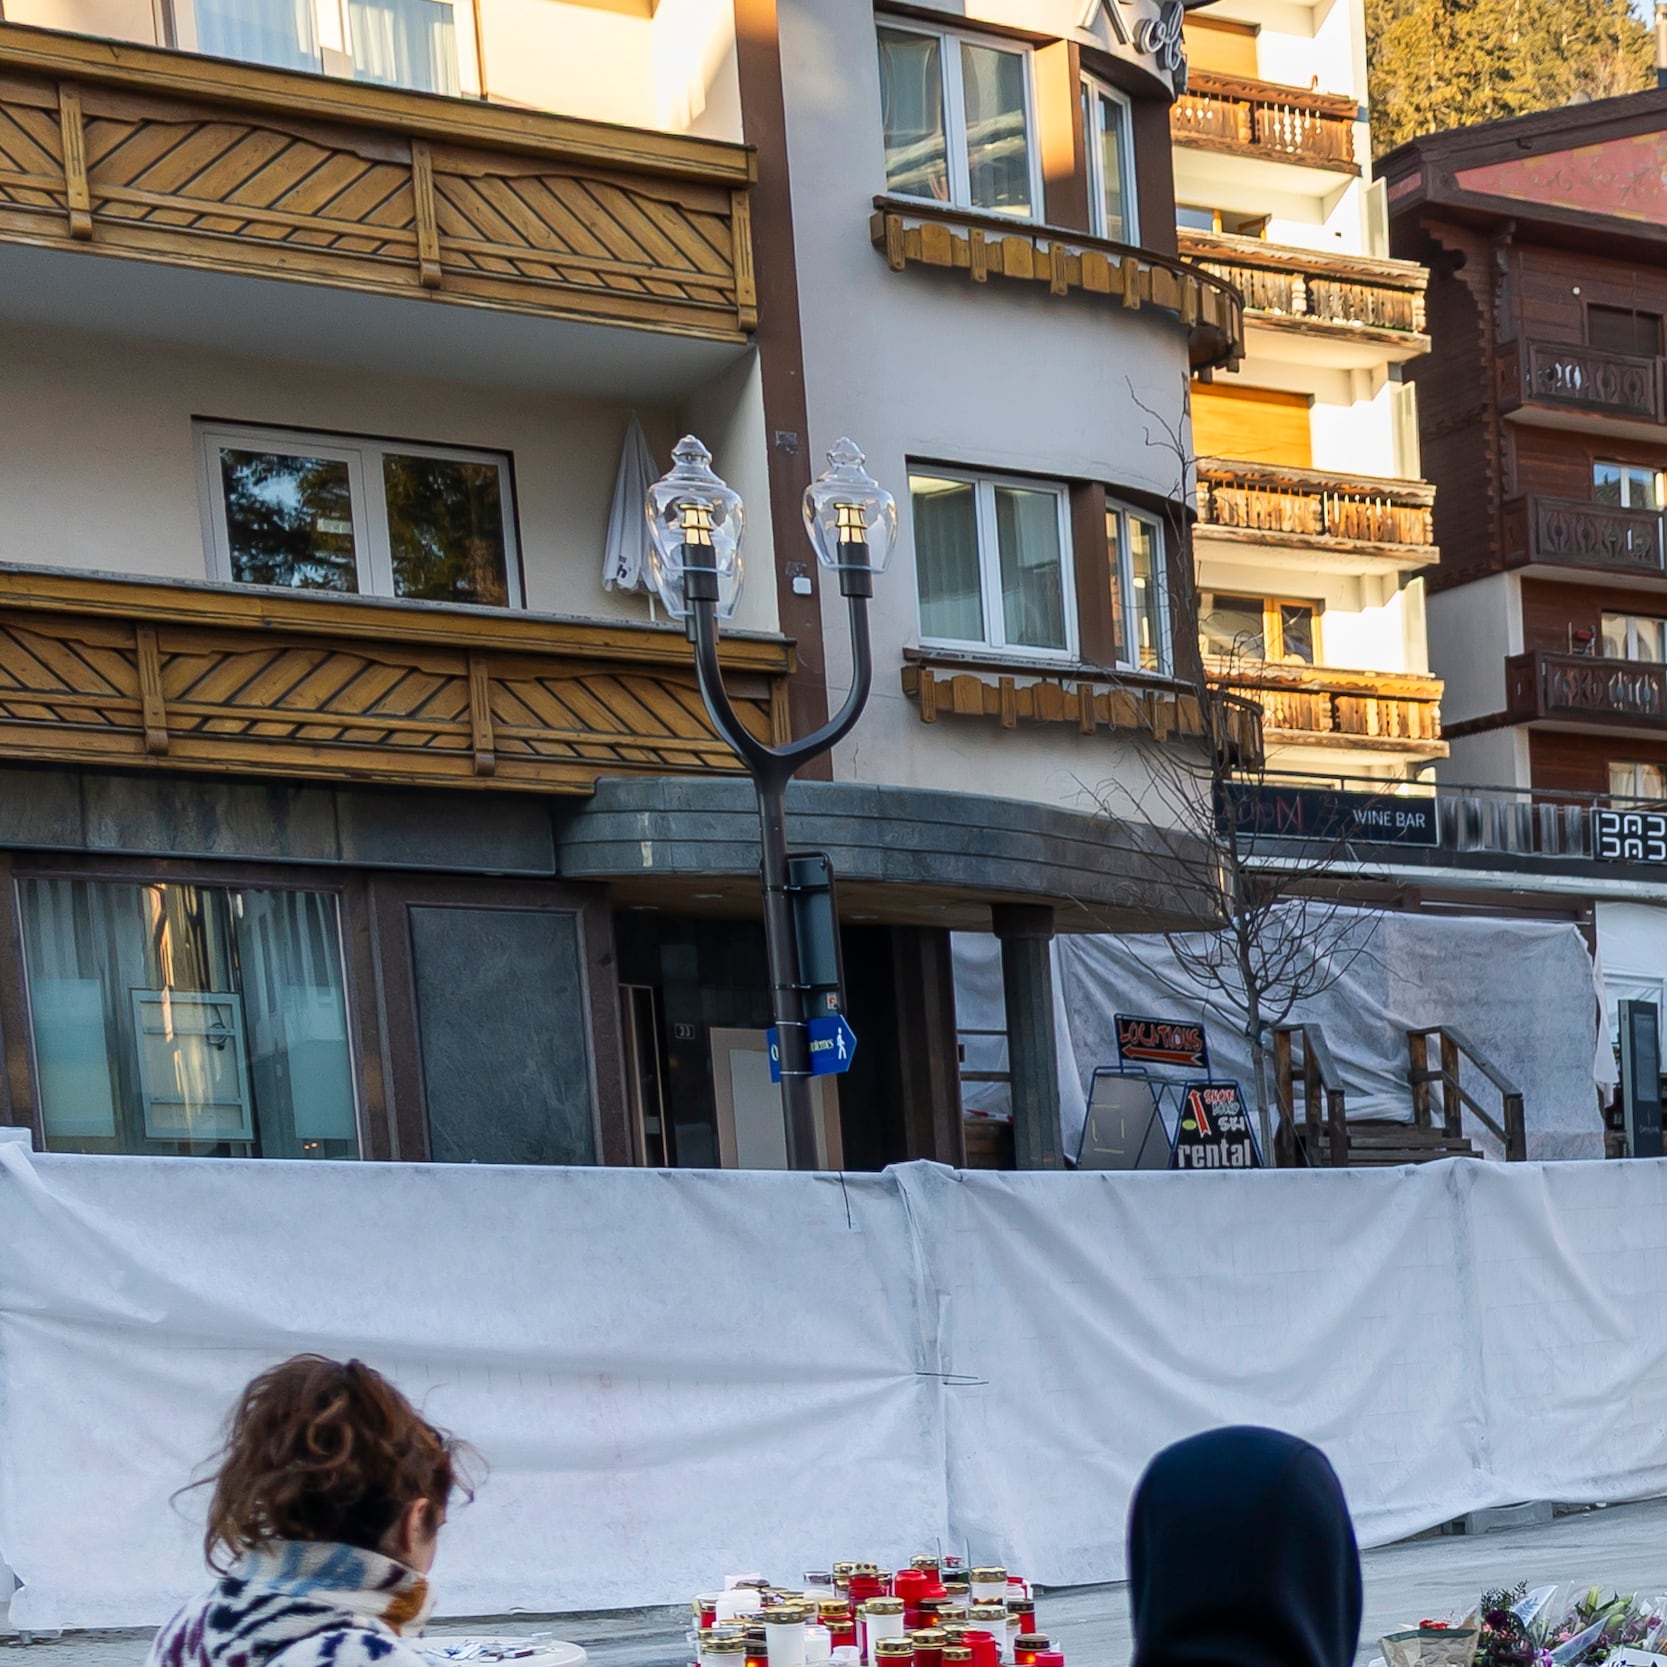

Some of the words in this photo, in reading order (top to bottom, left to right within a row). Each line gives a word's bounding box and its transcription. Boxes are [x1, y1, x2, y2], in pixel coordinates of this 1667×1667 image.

[1353, 809, 1391, 826] WINE
[1396, 811, 1426, 828] BAR
[1119, 1020, 1203, 1050] LOCATIONS
[1178, 1138, 1251, 1169] rental
